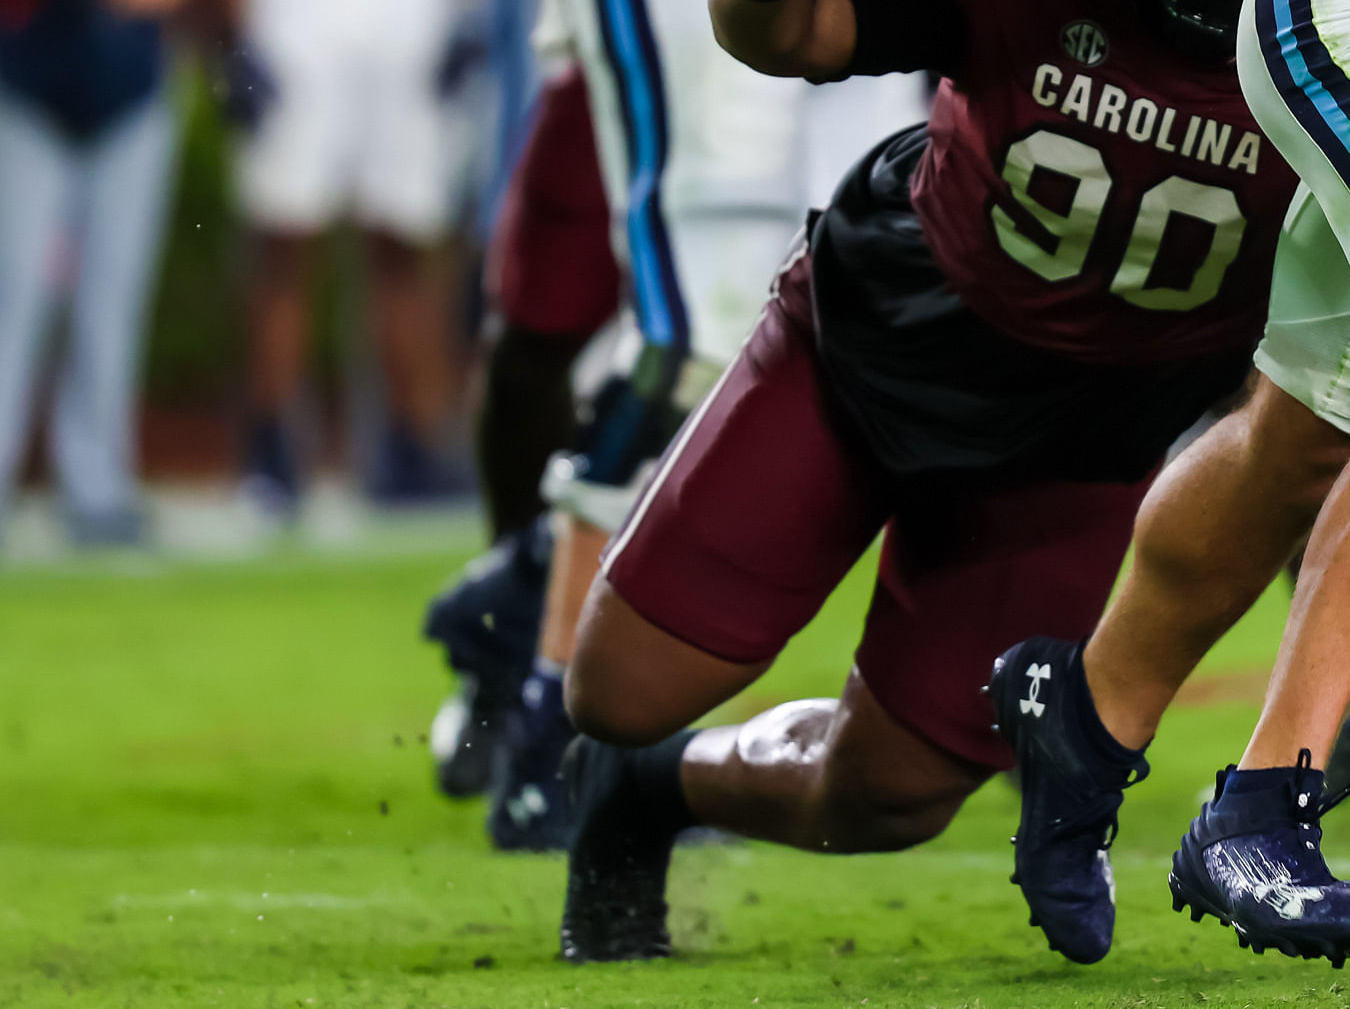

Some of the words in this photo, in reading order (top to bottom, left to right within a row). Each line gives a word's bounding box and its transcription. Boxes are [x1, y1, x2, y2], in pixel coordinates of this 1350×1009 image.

[1064, 23, 1105, 64] SEC
[1032, 63, 1261, 175] CAROLINA
[991, 129, 1248, 311] 90
